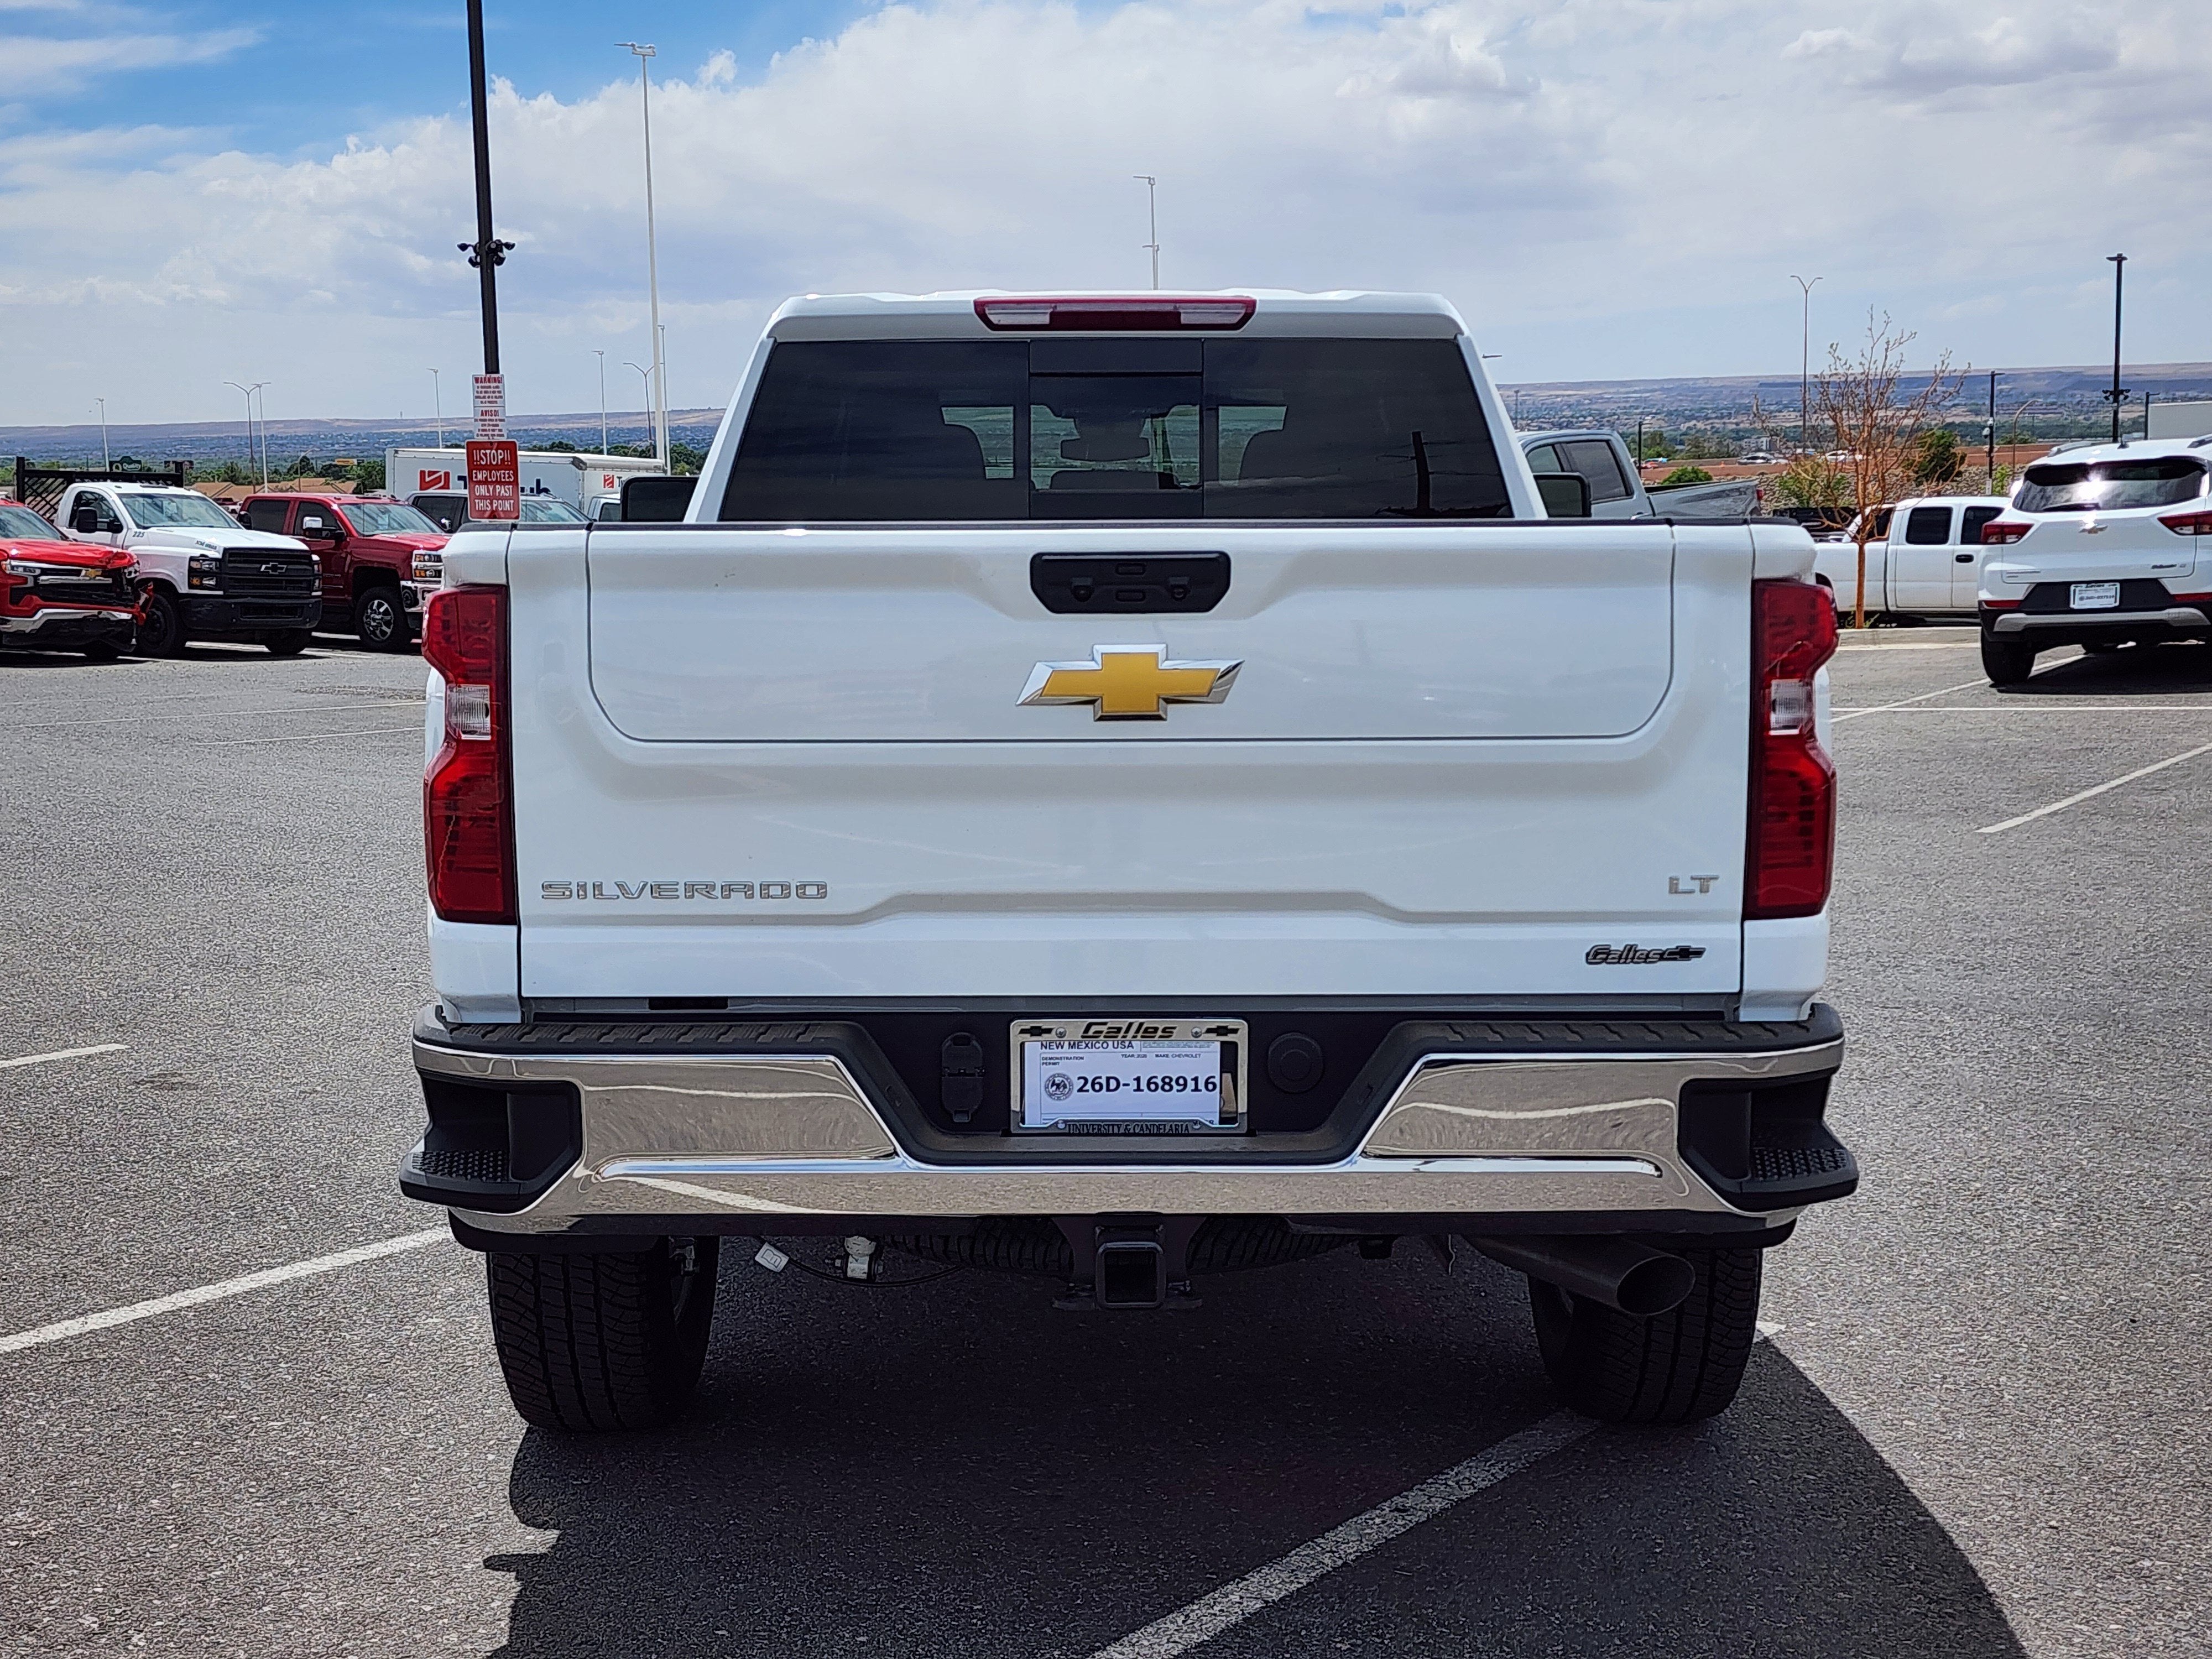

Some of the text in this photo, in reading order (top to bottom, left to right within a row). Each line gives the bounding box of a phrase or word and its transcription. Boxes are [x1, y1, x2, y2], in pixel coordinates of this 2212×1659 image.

[473, 450, 510, 465] !!STOP!!
[472, 470, 514, 482] EMPLOYEES
[474, 484, 494, 497] ONLY
[495, 484, 513, 496] PAST
[474, 499, 514, 512] THIS POINT
[541, 880, 828, 900] SILVERADO
[1668, 875, 1720, 894] LT
[1586, 943, 1666, 965] Galles
[1080, 1021, 1178, 1039] Galles
[1040, 1041, 1065, 1050] NEW
[1068, 1041, 1110, 1050] MEXICO
[1112, 1041, 1134, 1050] USA
[1076, 1075, 1217, 1093] 26D-168916
[1067, 1123, 1190, 1134] UNIVERSITY & CANDELARIA
